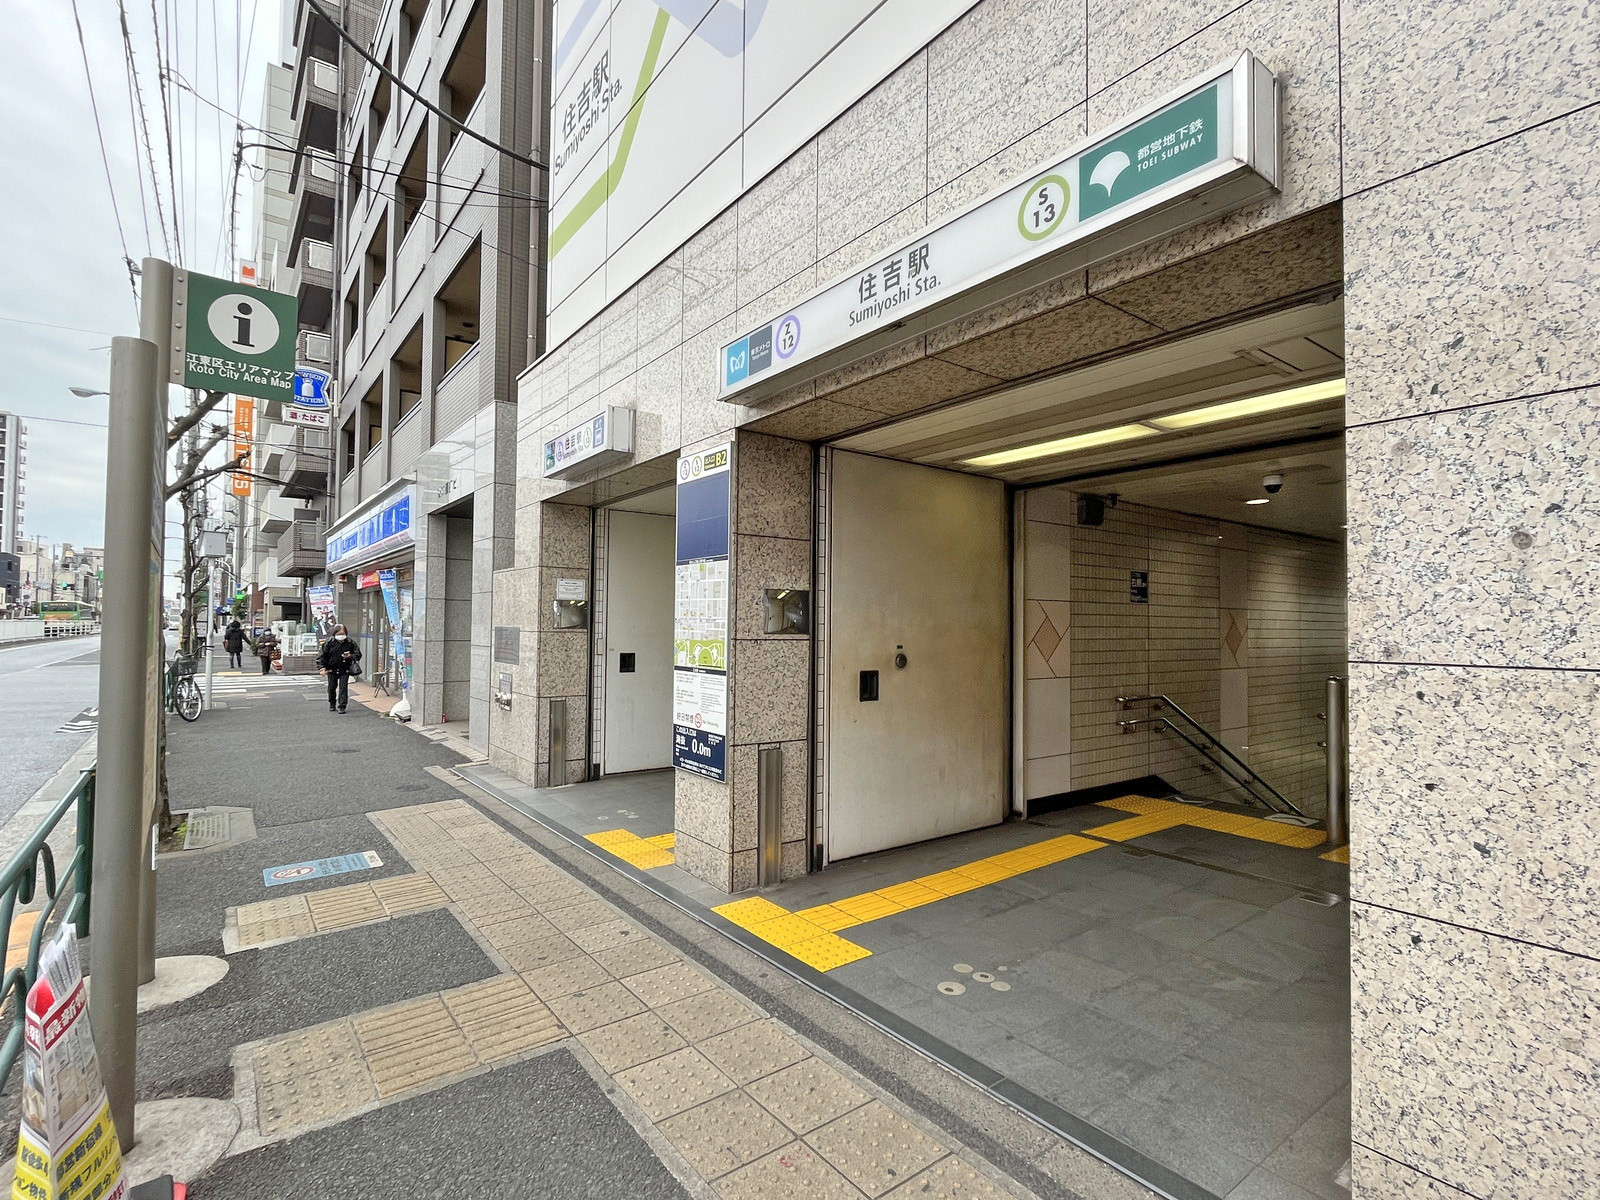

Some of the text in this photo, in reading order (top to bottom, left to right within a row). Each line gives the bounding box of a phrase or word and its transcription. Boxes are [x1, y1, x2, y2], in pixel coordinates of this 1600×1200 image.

[562, 49, 608, 144] 住吉駅
[555, 78, 622, 176] Sumiyoshi Sta.
[1137, 118, 1203, 161] 都営地下鉄
[1137, 133, 1204, 172] TOEI SUBWAY
[1038, 187, 1049, 206] S
[1033, 203, 1056, 229] 13
[858, 242, 929, 304] 住吉駅
[849, 275, 941, 327] Sumiyoshi Sta.
[785, 322, 791, 335] Z
[783, 335, 794, 350] 12
[186, 352, 295, 380] 江東区エリアマップ
[189, 362, 292, 389] Koto City Area Map
[716, 450, 727, 467] B2
[691, 738, 711, 758] 0.0m
